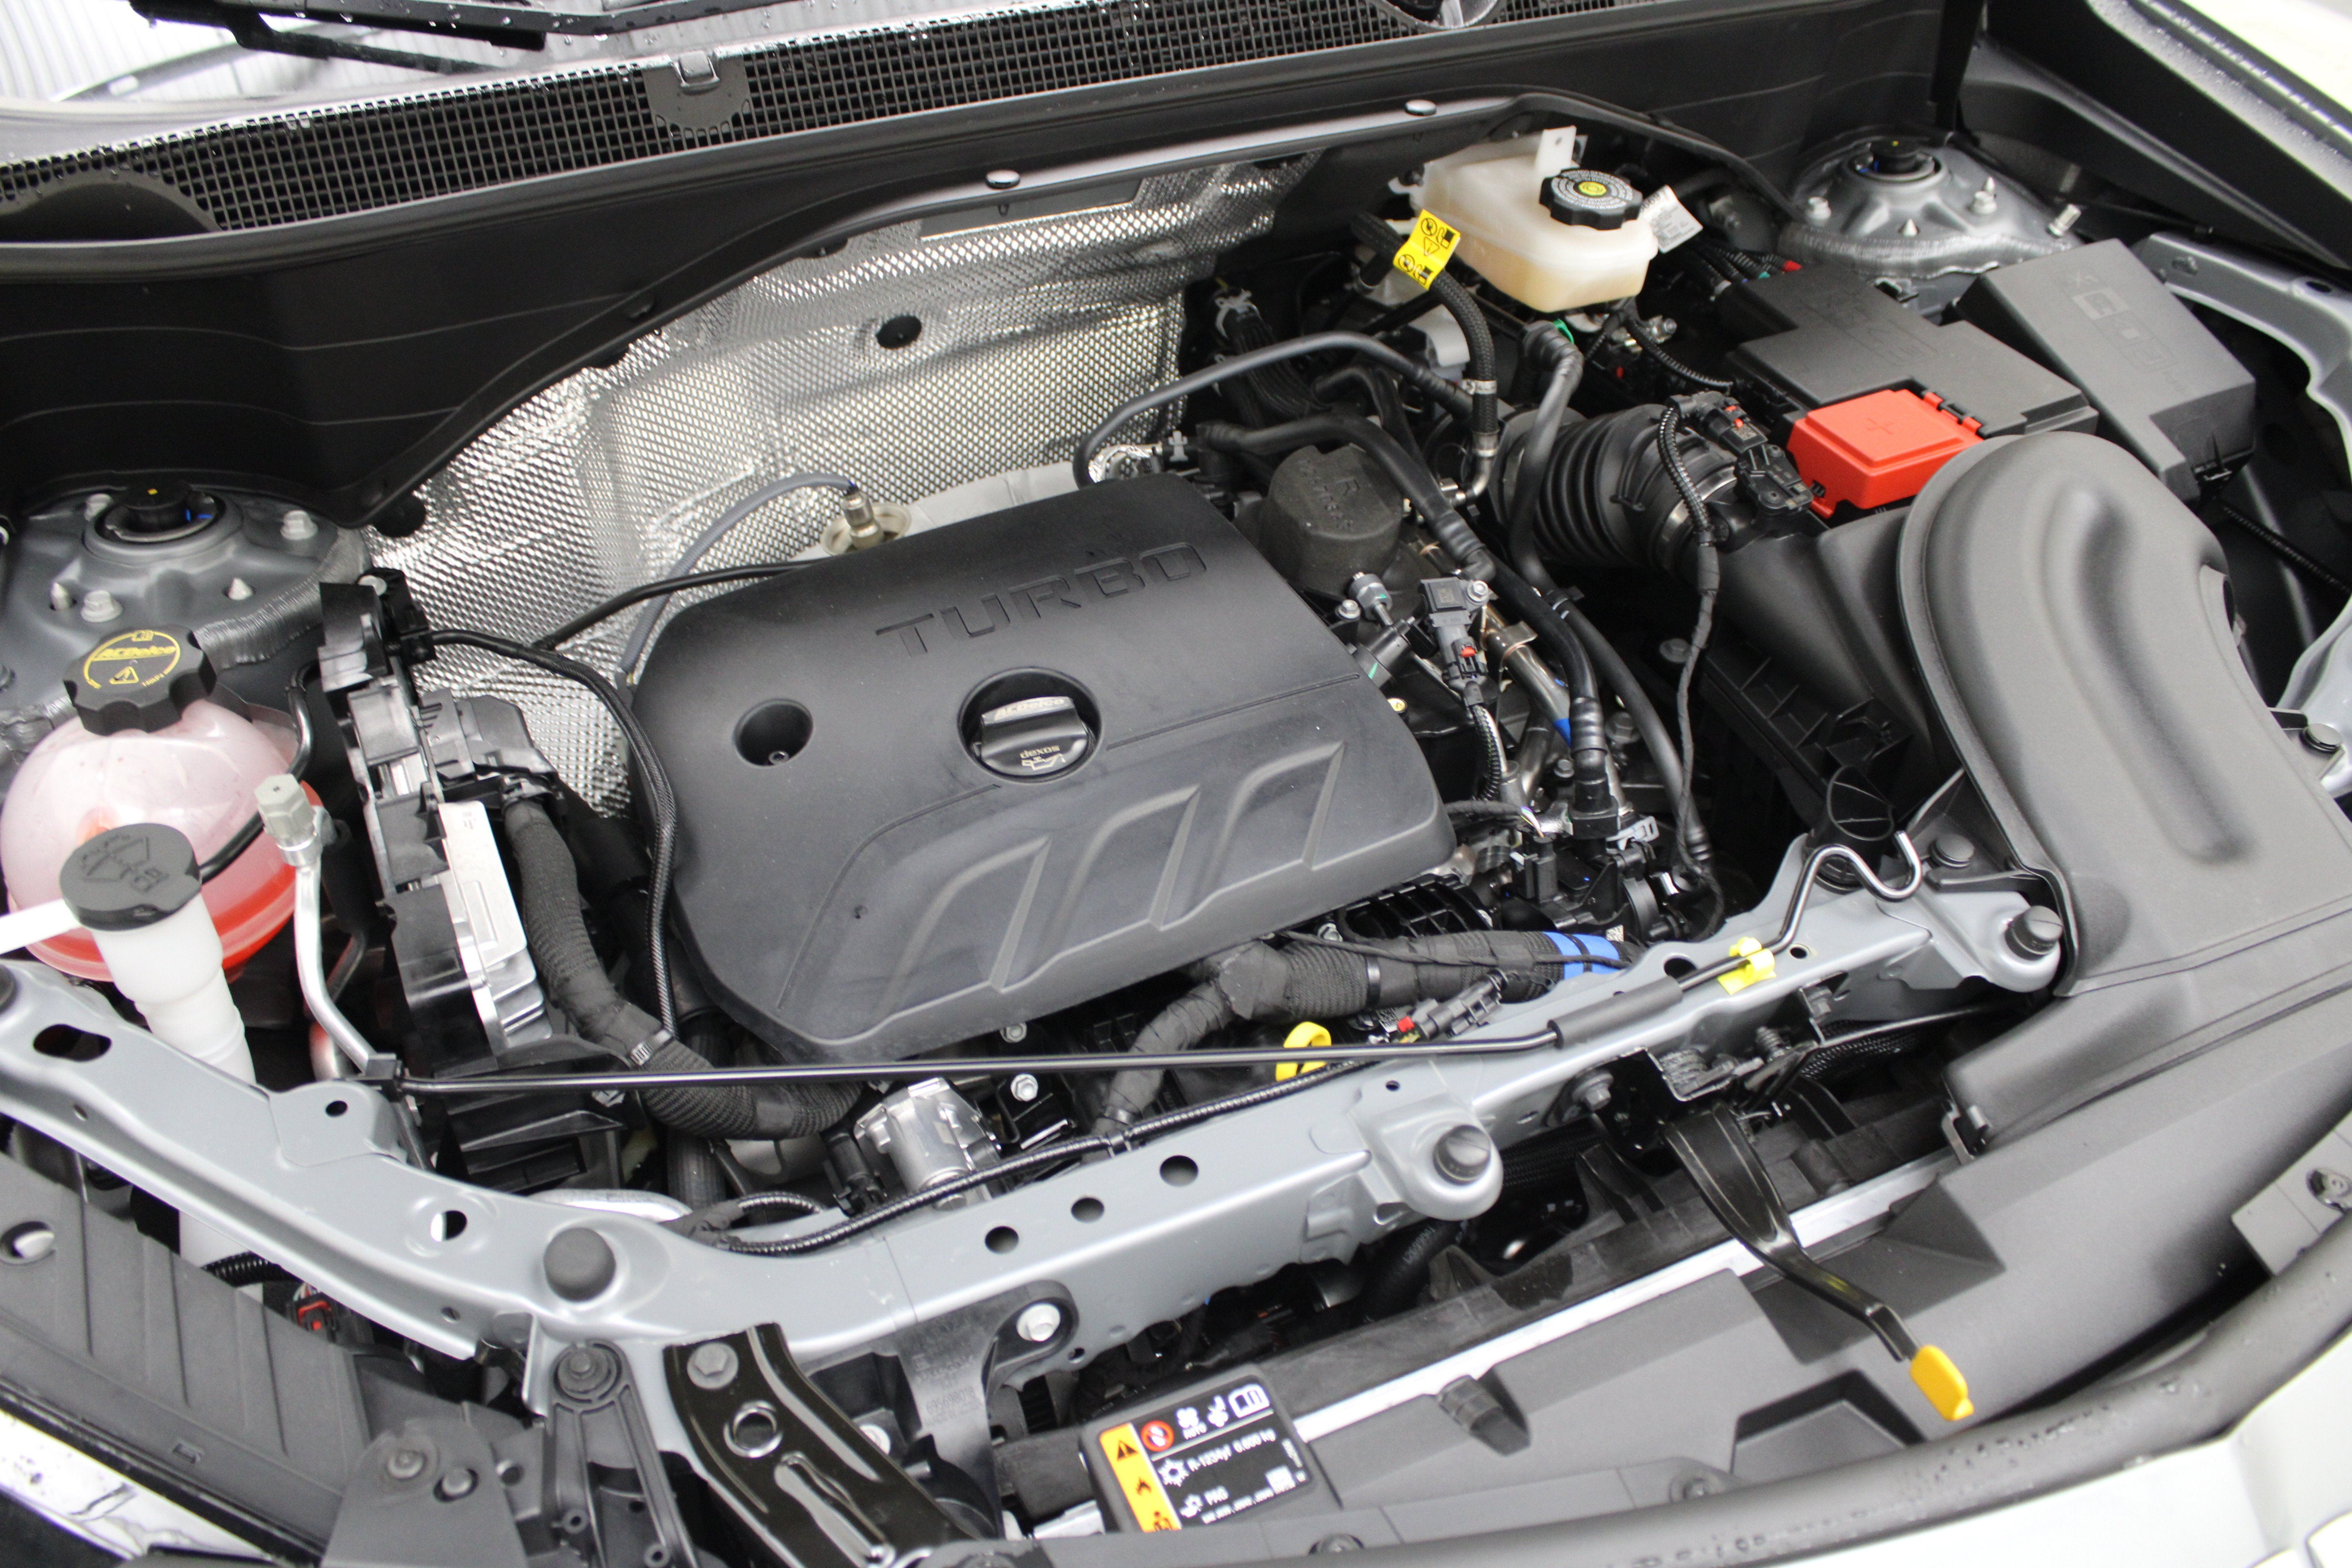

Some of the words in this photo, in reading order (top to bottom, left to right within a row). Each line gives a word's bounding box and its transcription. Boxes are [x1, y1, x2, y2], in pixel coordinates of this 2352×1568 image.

[876, 541, 1207, 657] TURBO
[1020, 744, 1060, 759] dexos
[1184, 1421, 1207, 1440] AUTO
[1203, 1486, 1229, 1506] PAG
